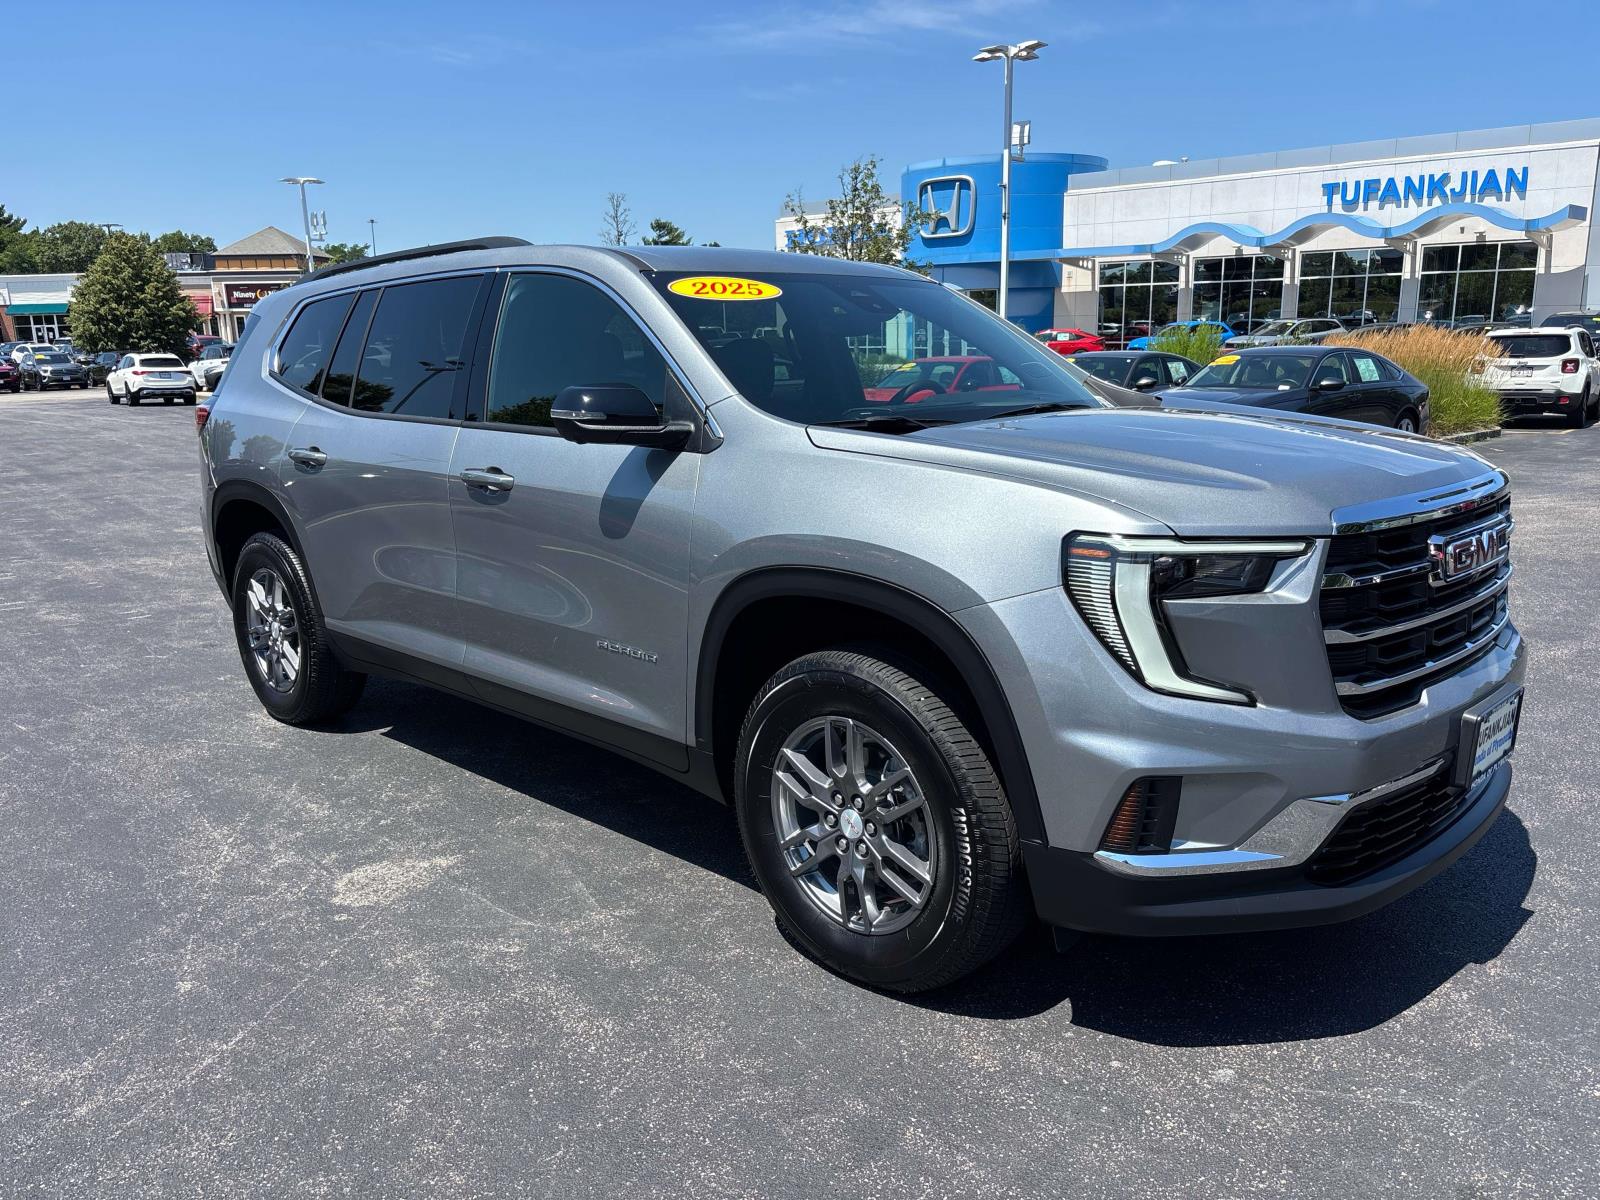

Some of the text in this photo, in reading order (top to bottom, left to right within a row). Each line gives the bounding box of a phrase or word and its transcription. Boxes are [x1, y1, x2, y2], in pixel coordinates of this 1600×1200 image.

[1322, 166, 1529, 206] TUFANKJIAN
[233, 291, 256, 299] Ninety
[692, 281, 763, 296] 2025
[1447, 524, 1508, 575] GMC
[596, 640, 658, 663] ACADIA
[1478, 706, 1517, 747] UFANKJIAN
[950, 807, 972, 923] BRIDGESTONE
